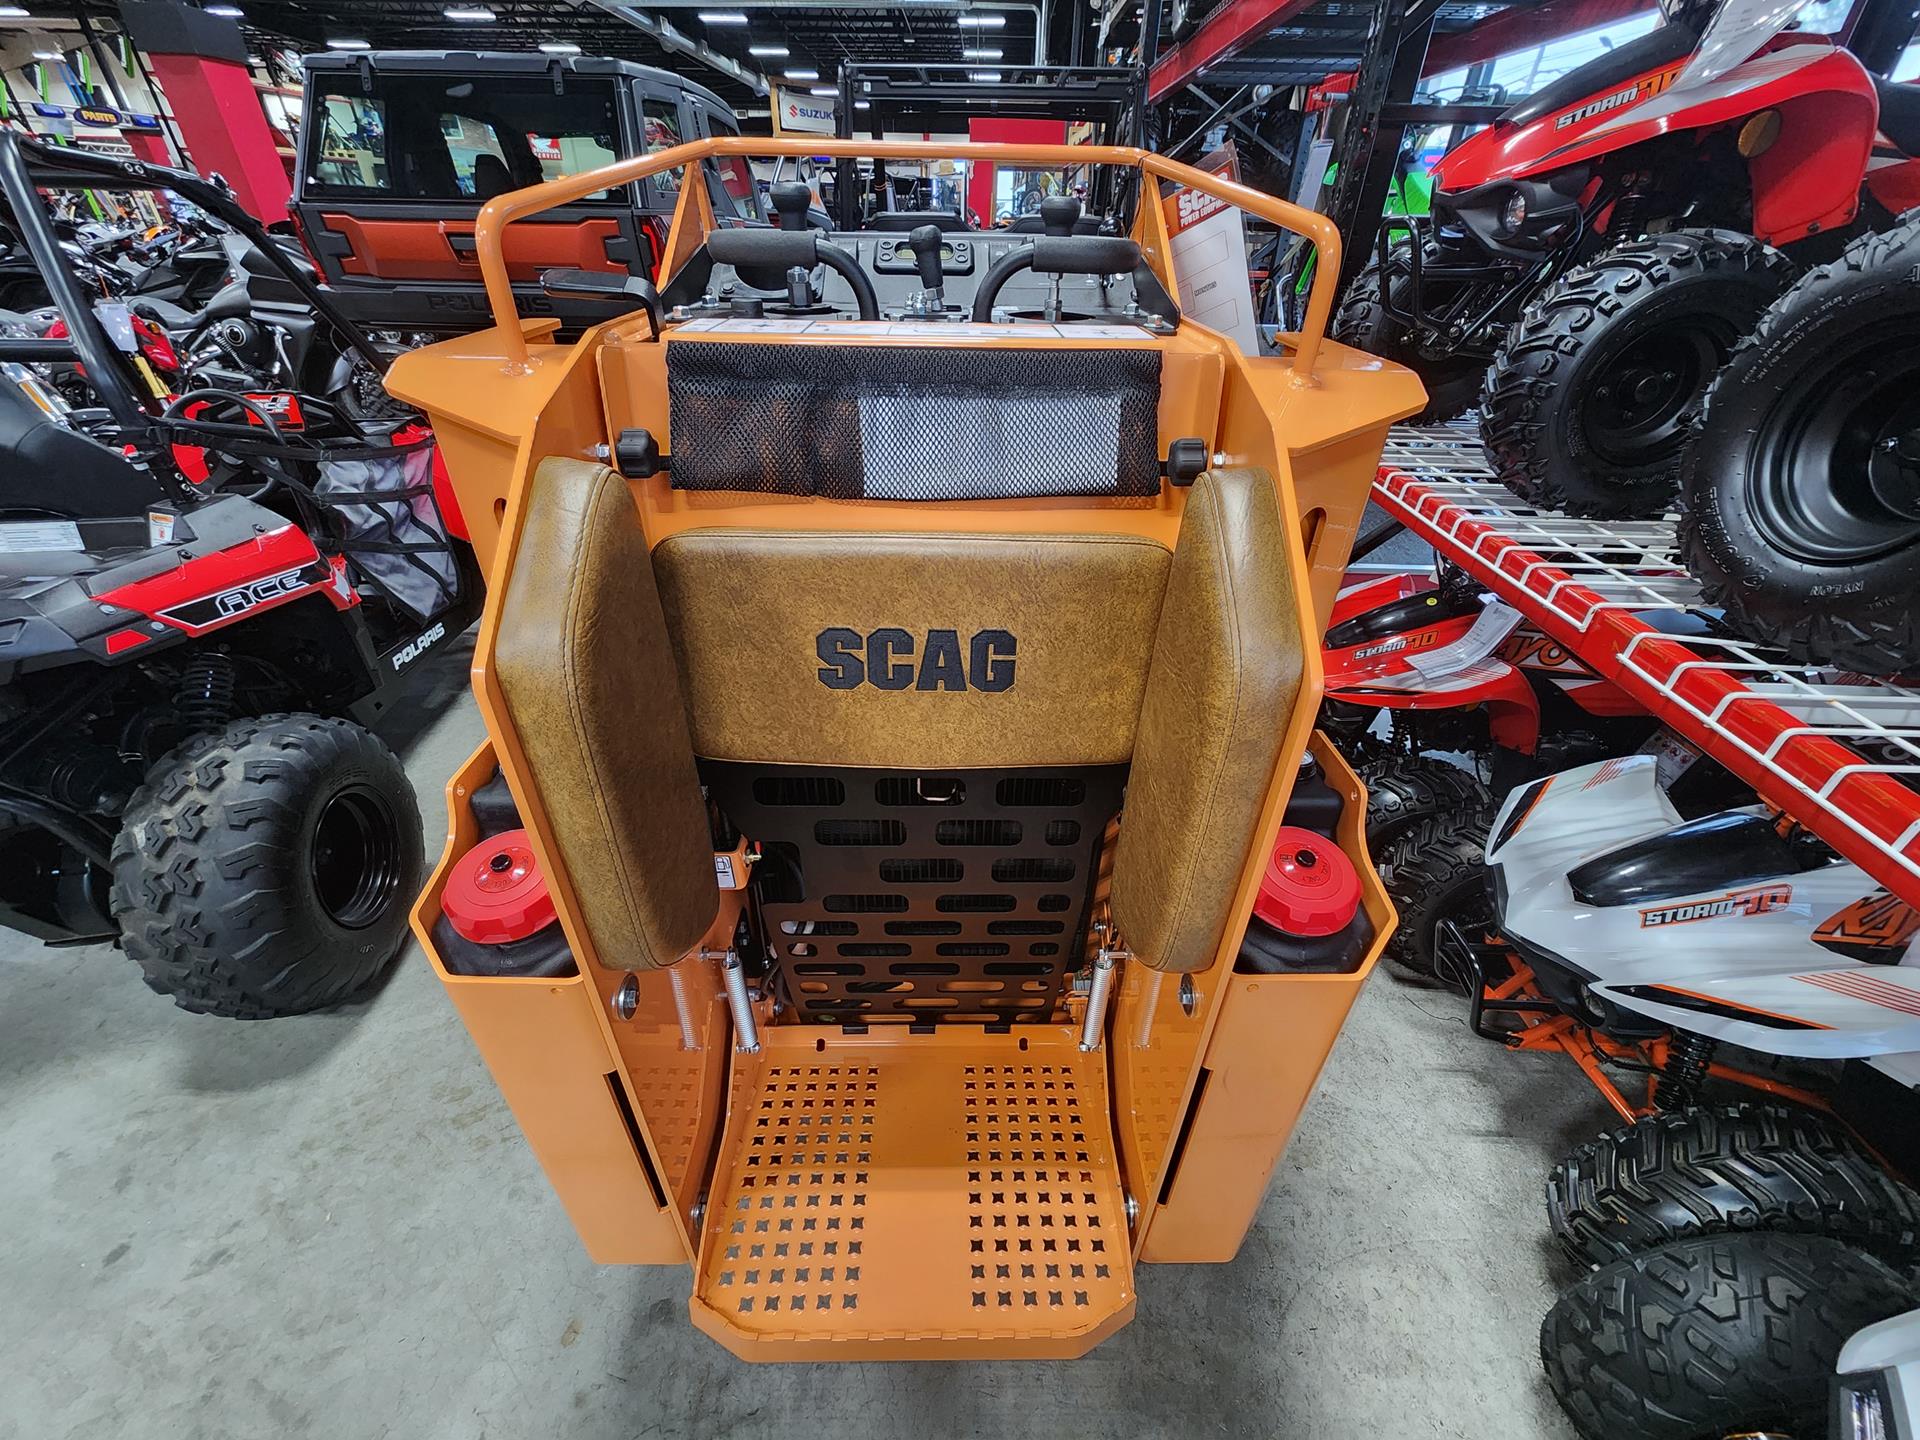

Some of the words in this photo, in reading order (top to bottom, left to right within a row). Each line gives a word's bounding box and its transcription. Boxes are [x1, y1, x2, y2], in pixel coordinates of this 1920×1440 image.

[80, 110, 117, 122] PARTS
[799, 108, 833, 120] SUZUK
[215, 569, 310, 616] ACE
[392, 621, 446, 671] POLARIS
[816, 627, 1018, 693] SCAG
